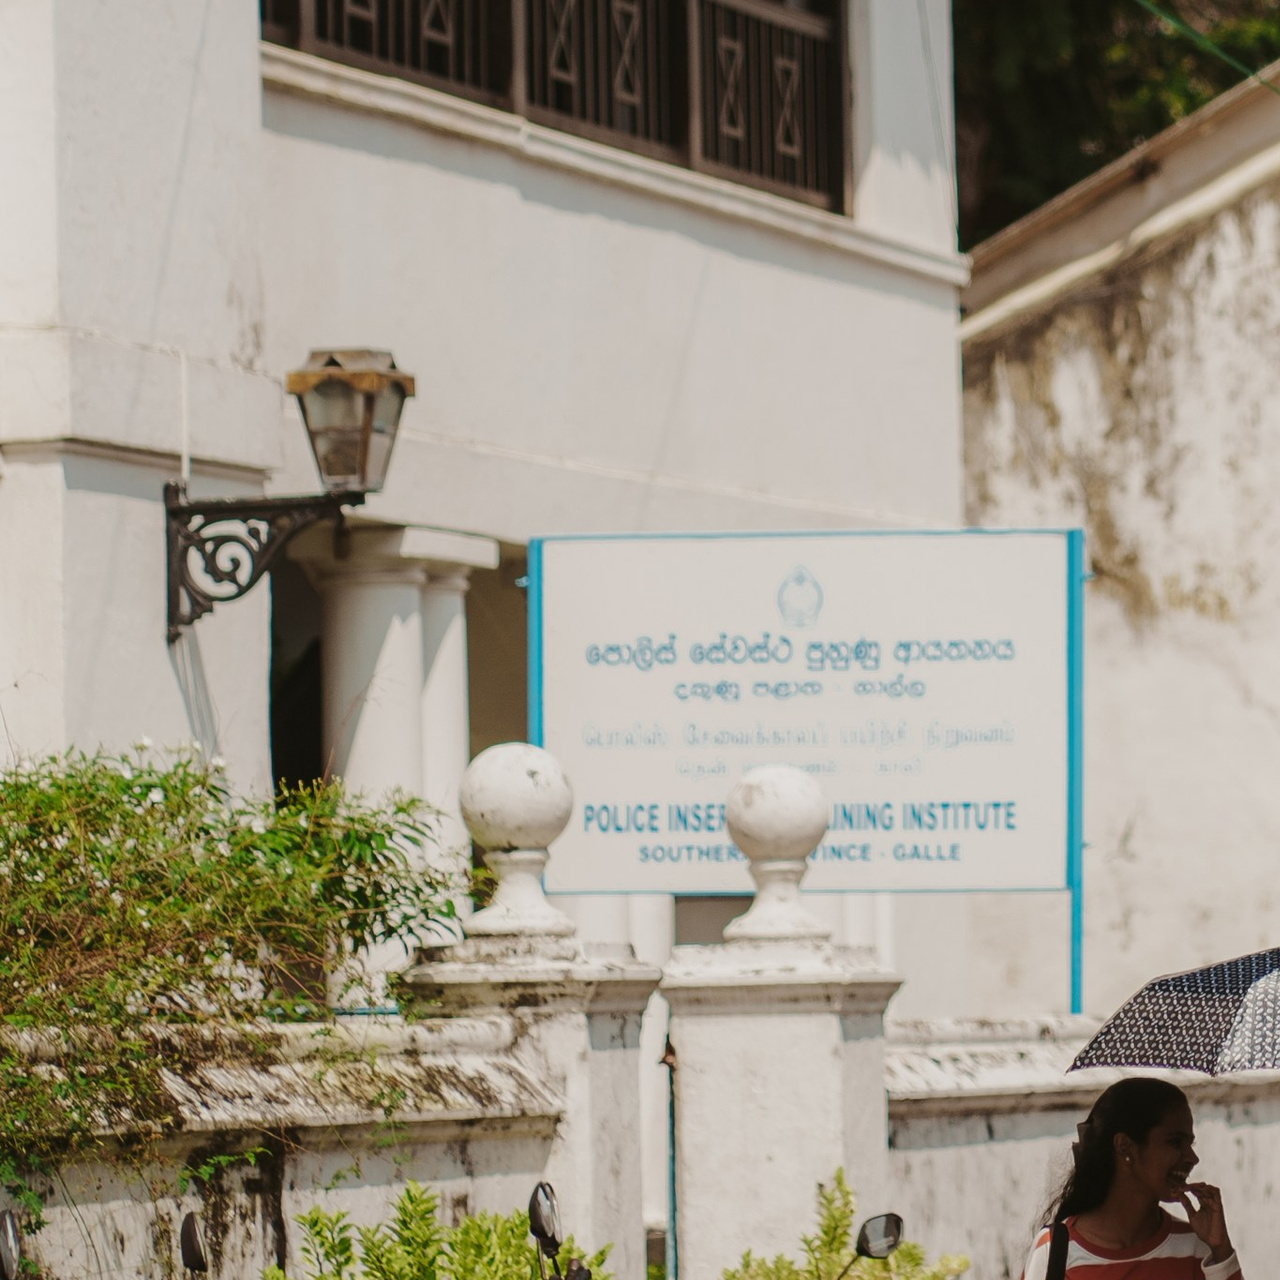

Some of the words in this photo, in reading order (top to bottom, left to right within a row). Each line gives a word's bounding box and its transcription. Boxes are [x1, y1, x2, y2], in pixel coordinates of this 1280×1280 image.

[584, 803, 660, 833] POLICE
[902, 801, 1016, 830] INSTITUTE
[893, 842, 961, 862] GALLE
